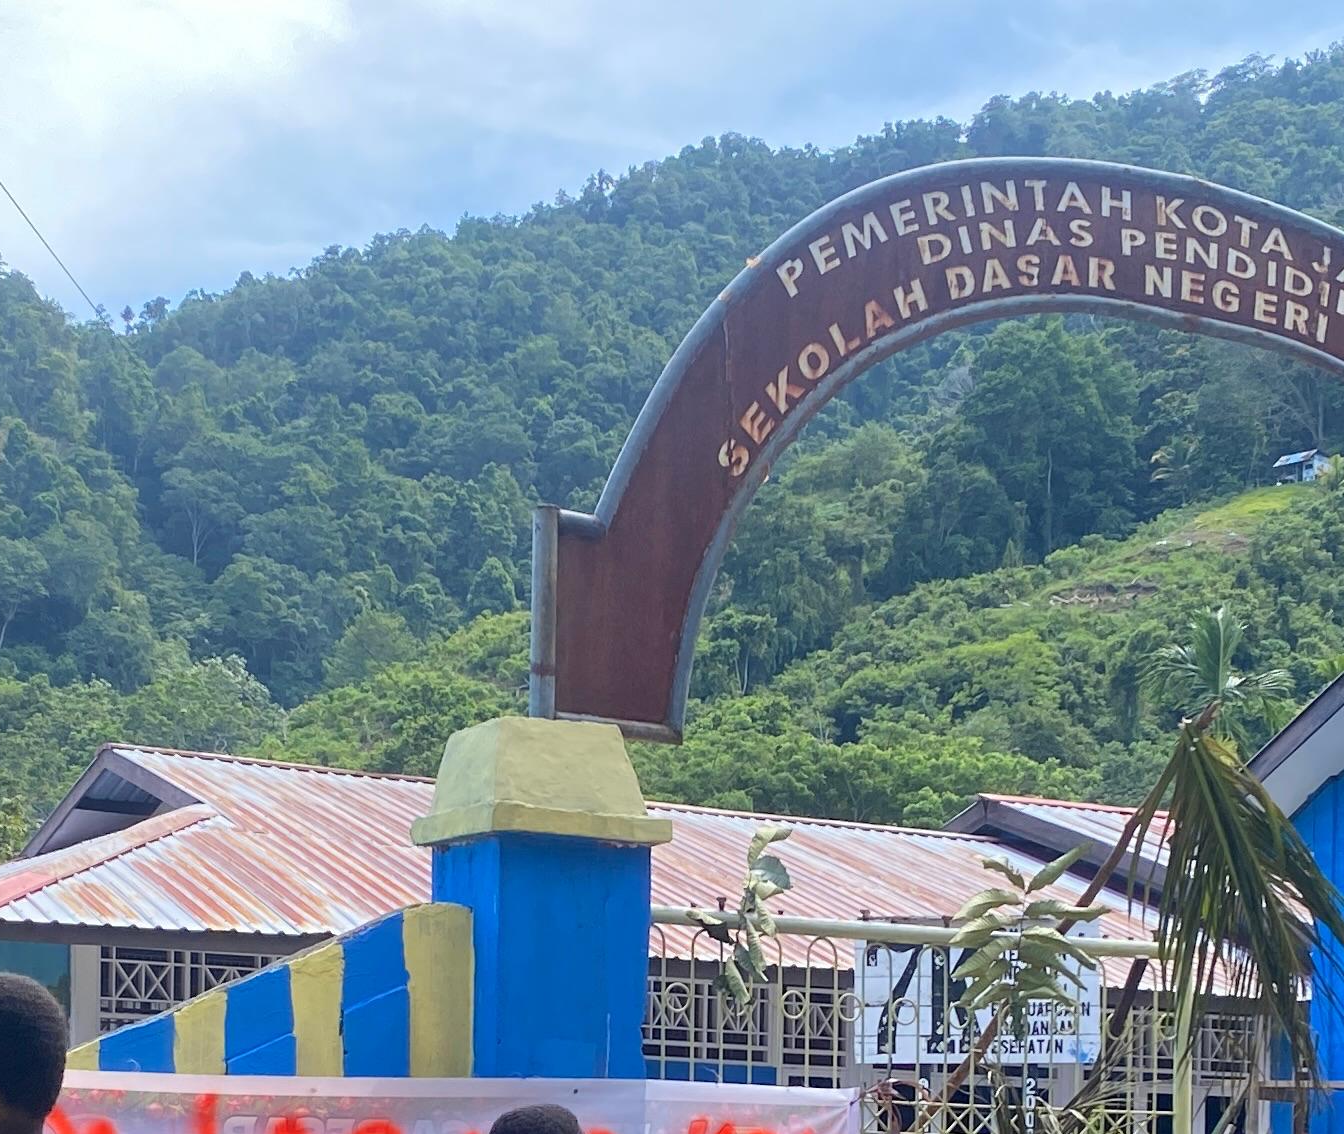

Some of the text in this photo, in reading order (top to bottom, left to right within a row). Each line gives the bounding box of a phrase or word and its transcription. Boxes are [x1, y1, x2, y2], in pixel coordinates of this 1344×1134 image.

[776, 179, 1133, 298] PEMERINTAH
[1156, 195, 1293, 261] KOTA
[916, 216, 1094, 265] DINAS
[718, 279, 929, 477] SEKOLAH
[945, 253, 1116, 300] DASAR
[1145, 265, 1328, 343] NEGERI
